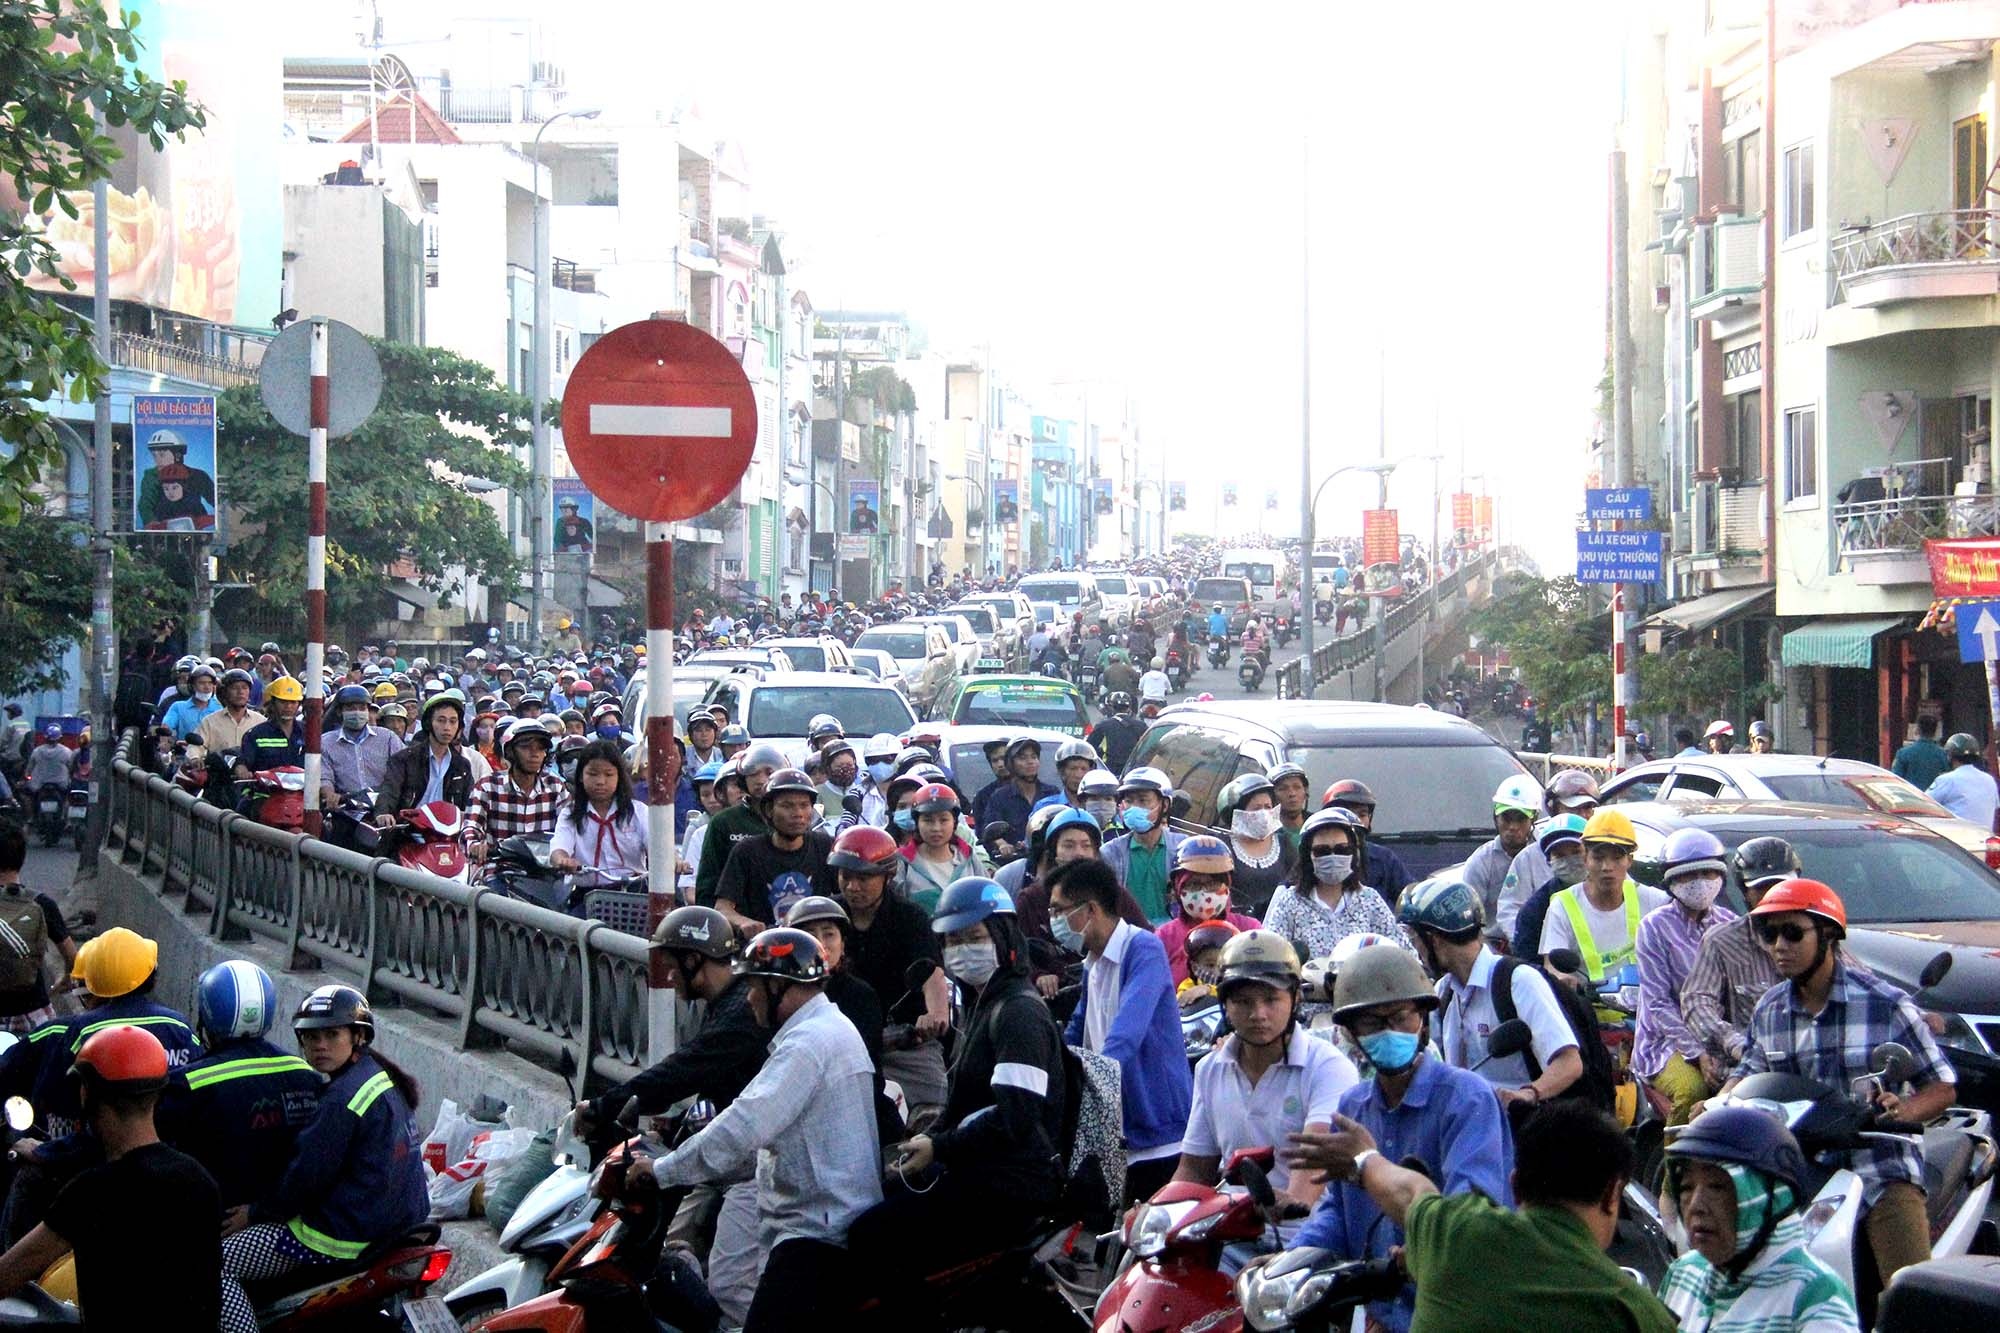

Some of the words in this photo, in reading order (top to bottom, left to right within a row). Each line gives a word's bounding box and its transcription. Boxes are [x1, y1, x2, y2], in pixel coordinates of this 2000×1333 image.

[1592, 506, 1624, 519] KÊNH
[1606, 535, 1619, 545] XE
[1577, 551, 1596, 562] KHU
